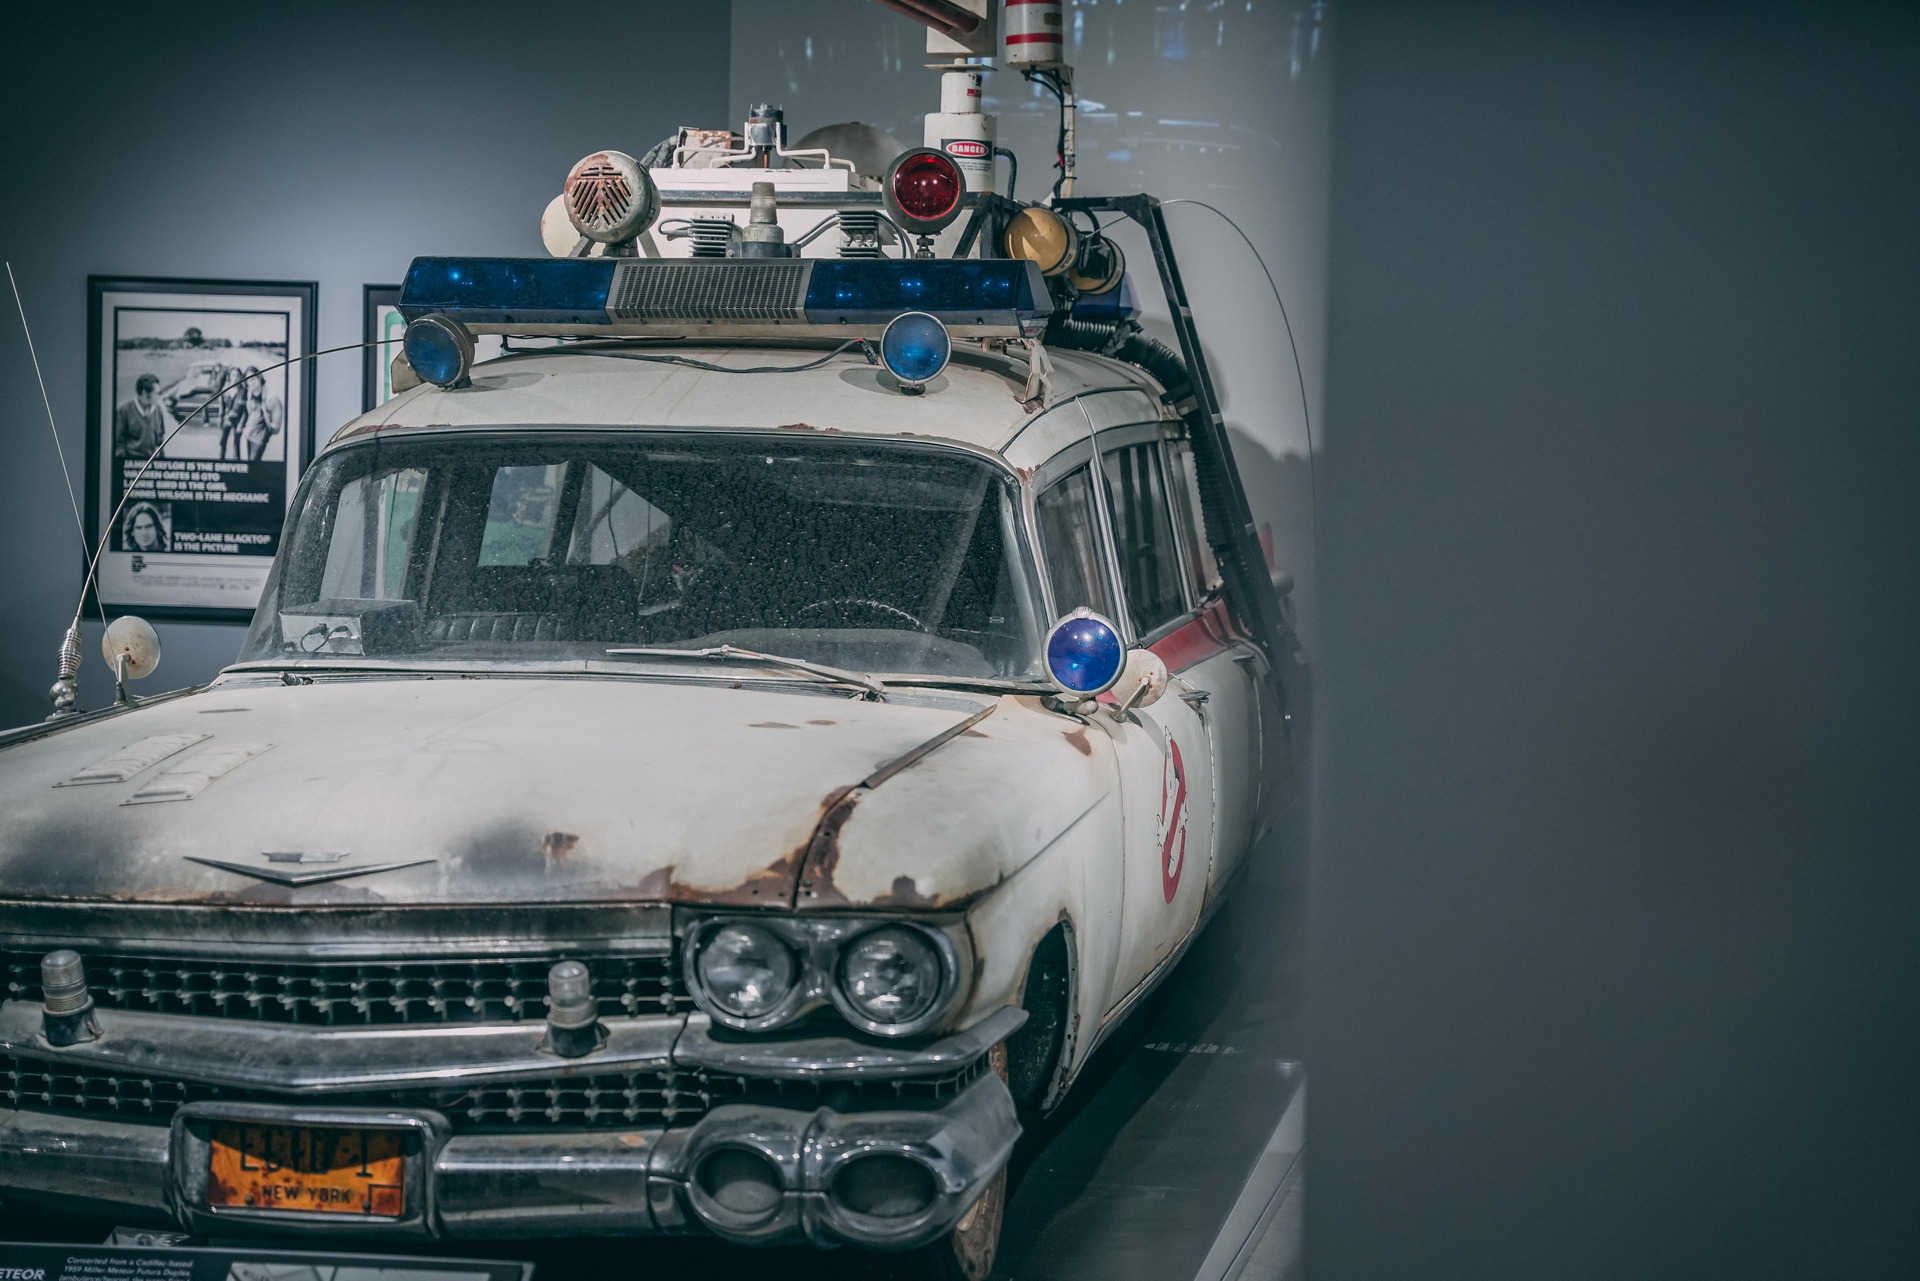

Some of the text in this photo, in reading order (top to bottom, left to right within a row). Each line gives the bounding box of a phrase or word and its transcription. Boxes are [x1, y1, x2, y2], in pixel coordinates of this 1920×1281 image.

[951, 144, 985, 153] DANGER
[262, 1184, 351, 1204] NEW YORK
[67, 1256, 108, 1265] Converted
[109, 1258, 127, 1266] from
[163, 1270, 190, 1278] Duplex
